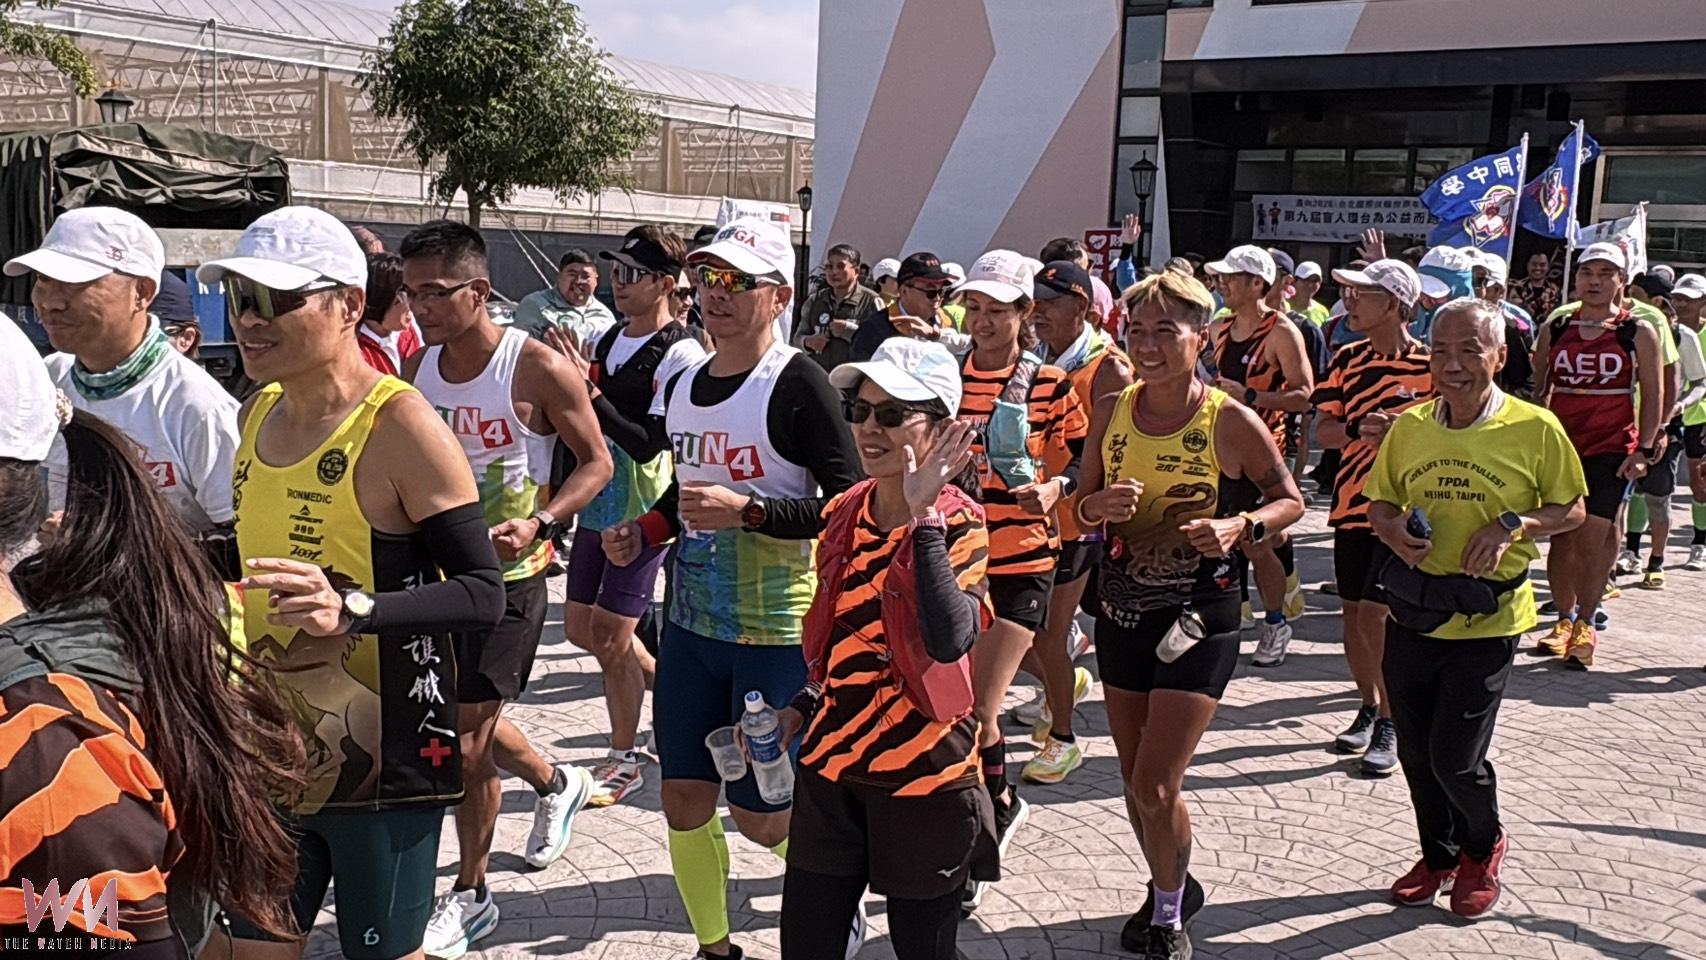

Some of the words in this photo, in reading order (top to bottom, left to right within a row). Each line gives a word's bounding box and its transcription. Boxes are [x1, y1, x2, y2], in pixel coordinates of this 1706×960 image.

[1554, 350, 1623, 376] AED
[1422, 460, 1438, 472] LIFE
[1453, 459, 1469, 468] THE
[1471, 463, 1506, 489] FULLEST
[1437, 477, 1470, 488] TPDA
[1456, 491, 1486, 502] TAIPEI
